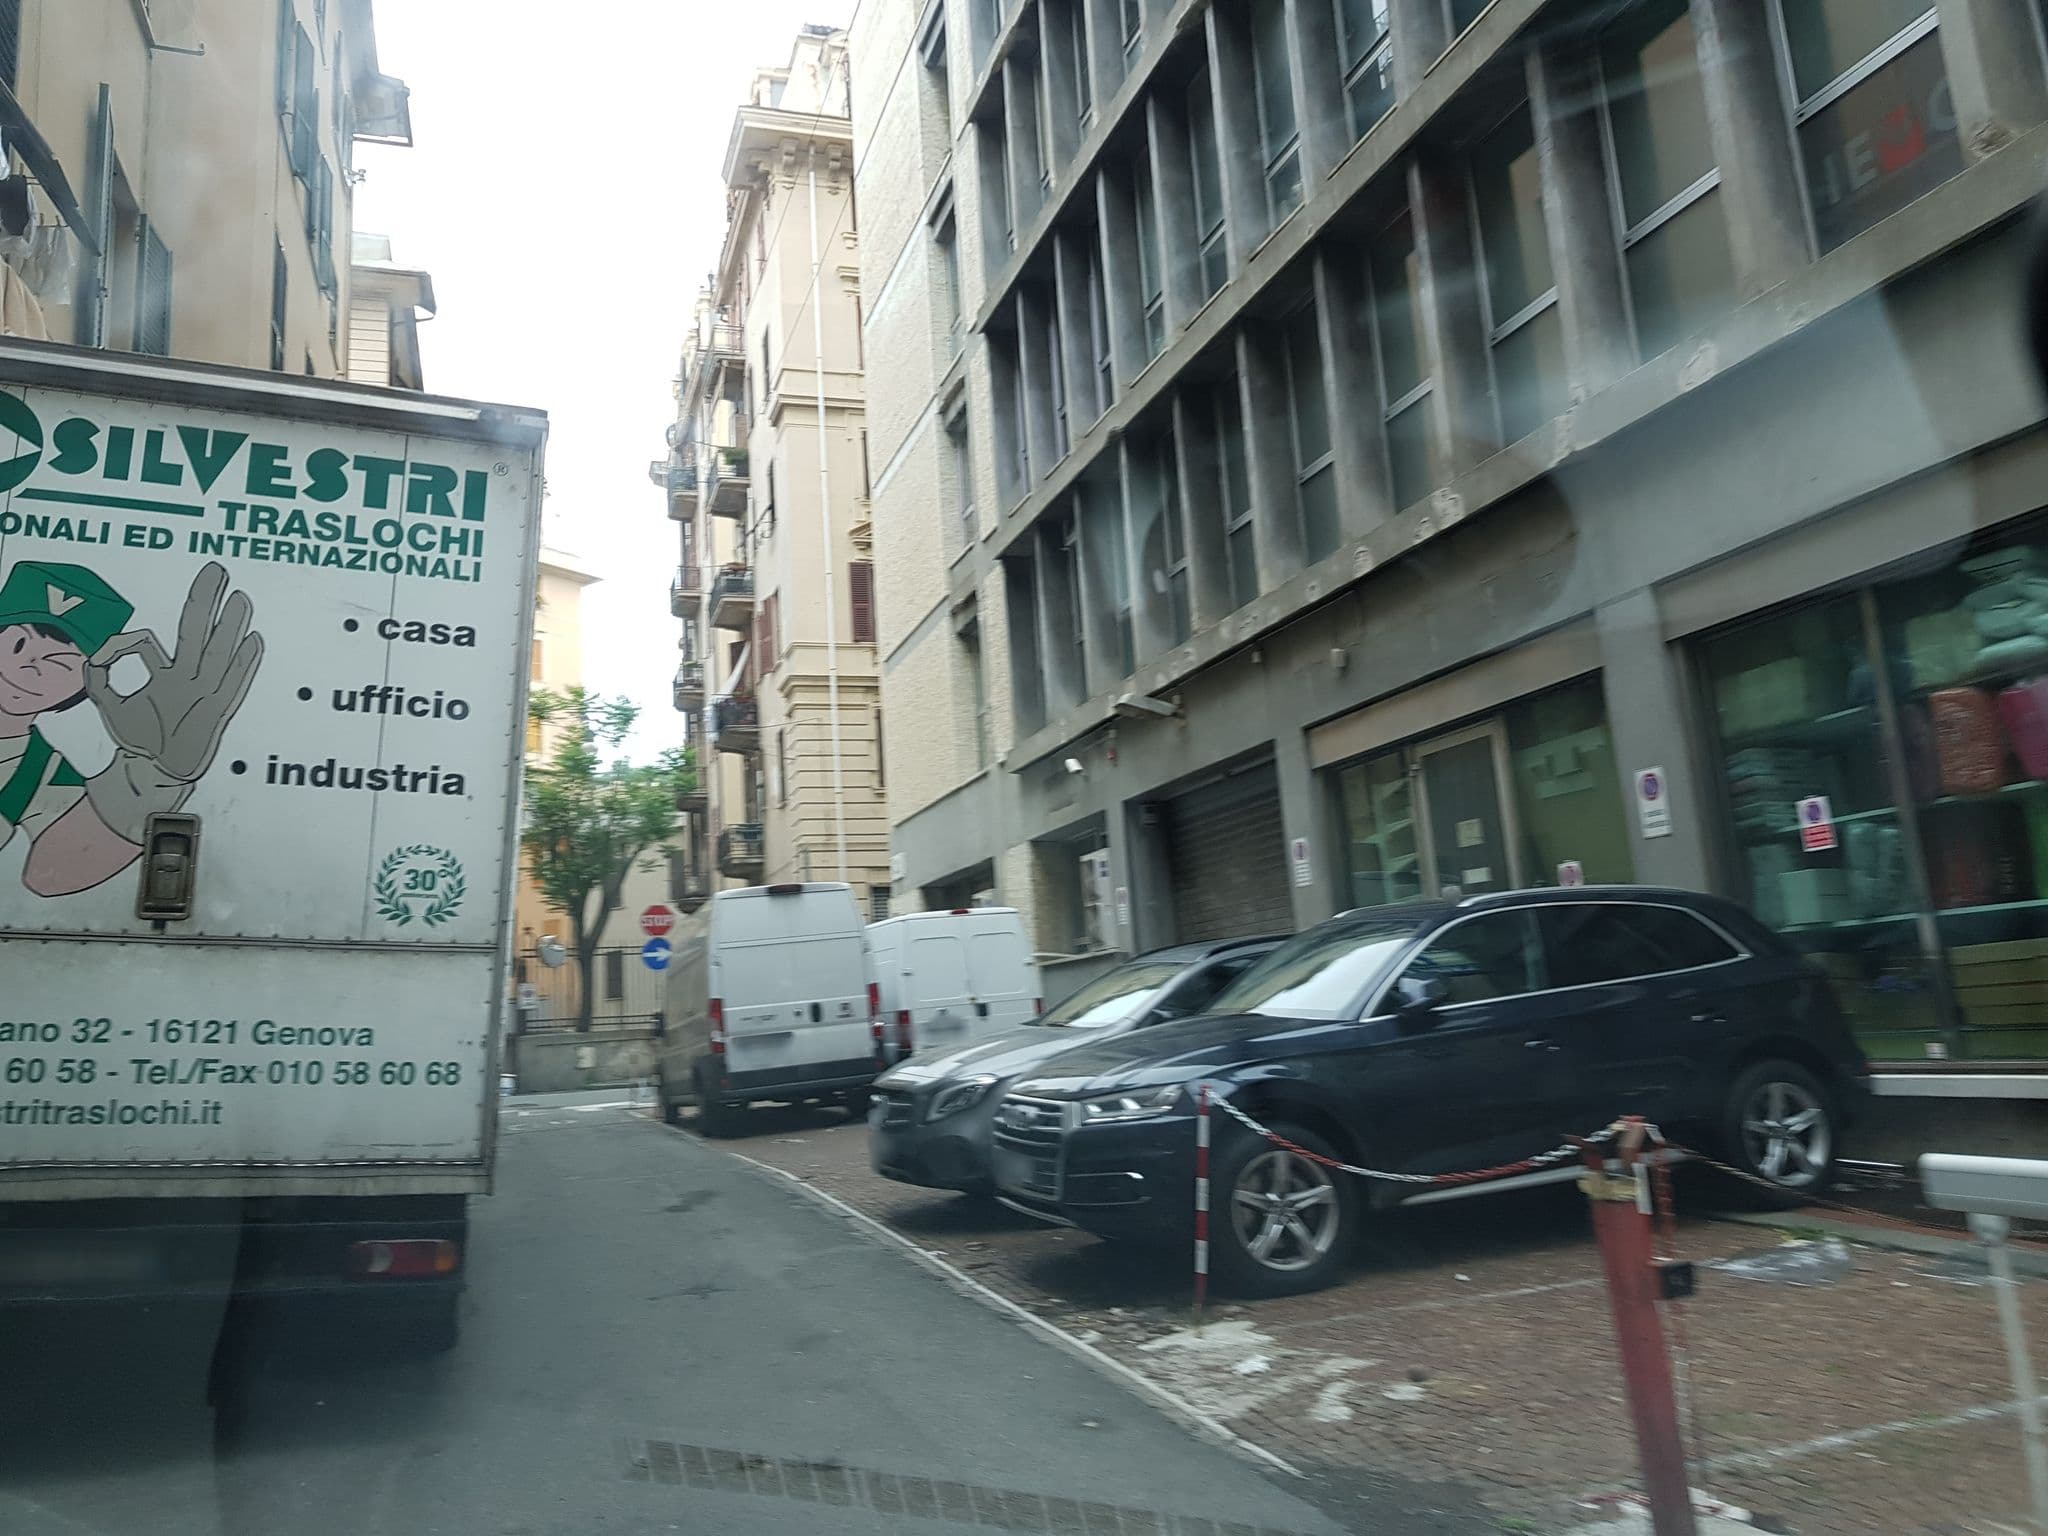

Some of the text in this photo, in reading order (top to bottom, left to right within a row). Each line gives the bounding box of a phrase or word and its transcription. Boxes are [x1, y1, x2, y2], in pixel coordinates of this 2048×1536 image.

[47, 417, 488, 521] SILVESTRI
[0, 511, 482, 583] ONALI ED INTERNAZIONALI
[217, 500, 484, 558] TRASLOCHI
[377, 617, 476, 648] casa
[332, 684, 470, 720] ufficio
[265, 754, 465, 796] industria
[71, 1017, 112, 1044] 32
[146, 1018, 238, 1045] 16121
[251, 1019, 374, 1047] Genova
[5, 1057, 46, 1084] 60
[56, 1058, 97, 1084] 58
[267, 1060, 324, 1086] 010
[332, 1060, 370, 1086] 58
[379, 1061, 416, 1086] 60
[425, 1061, 461, 1086] 68
[0, 1098, 223, 1126] tritraslochi.it
